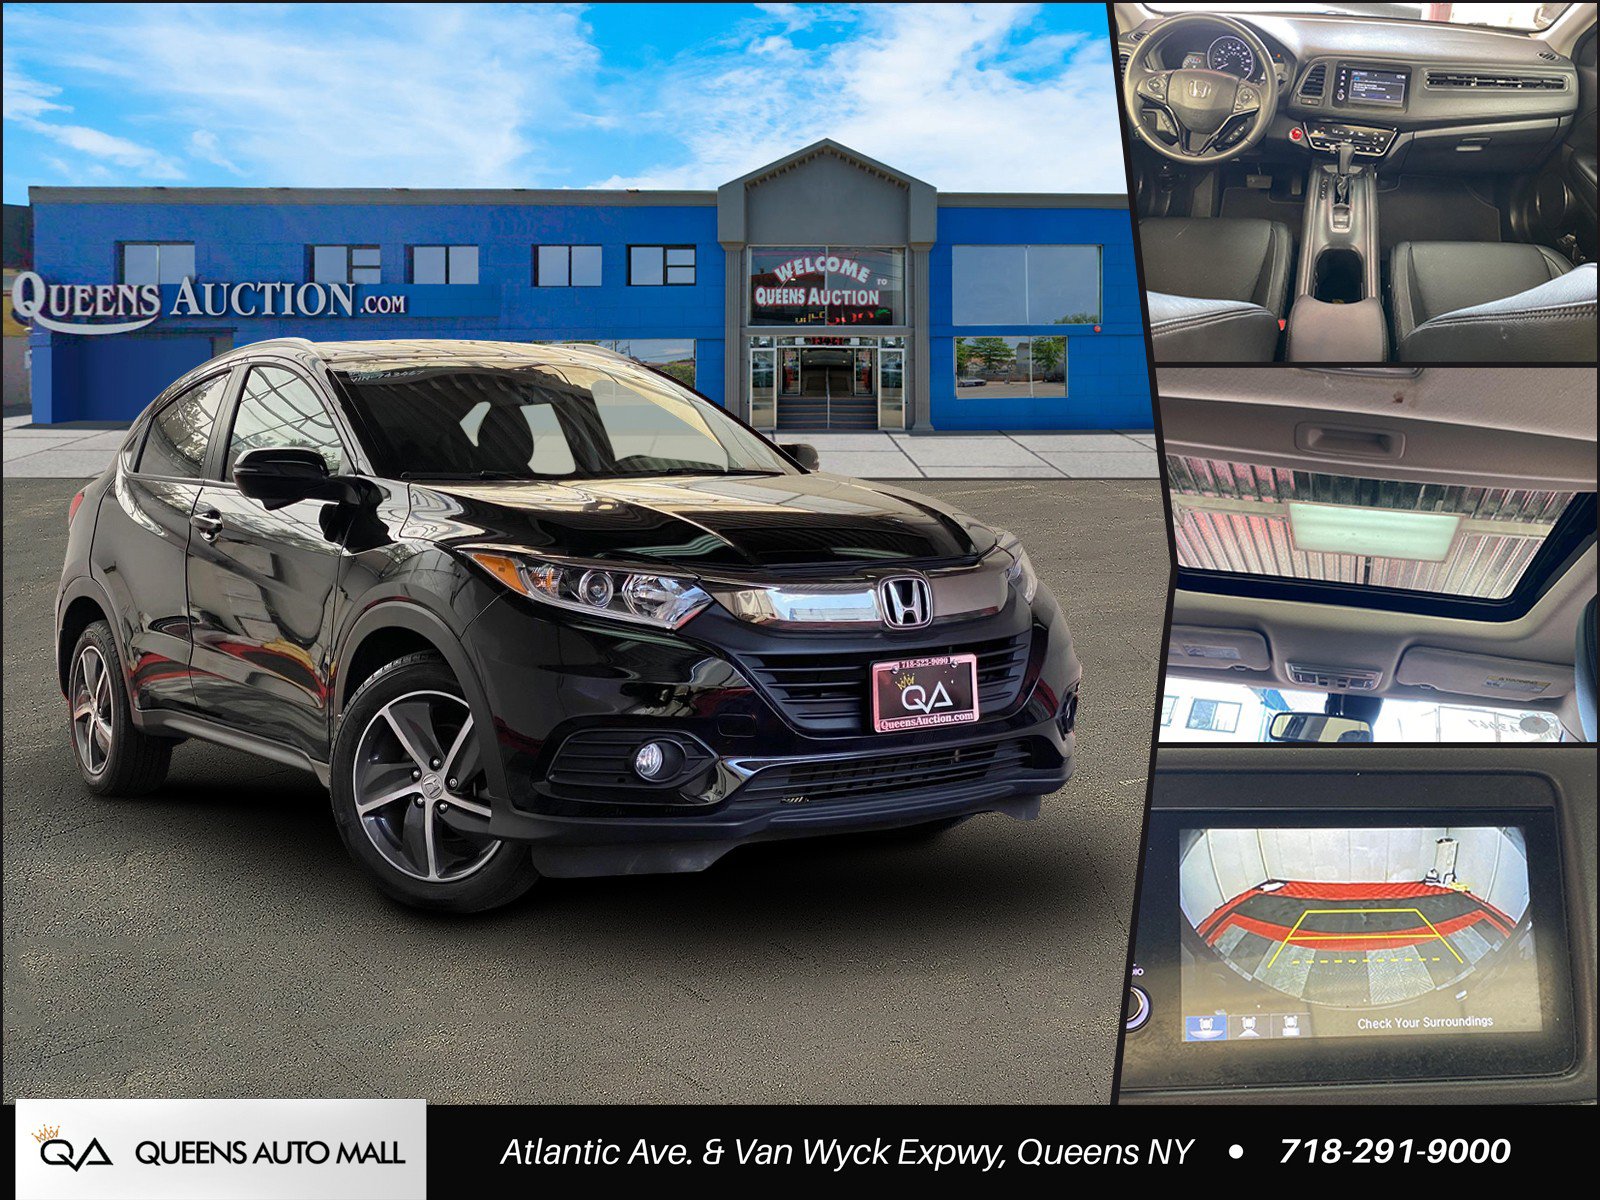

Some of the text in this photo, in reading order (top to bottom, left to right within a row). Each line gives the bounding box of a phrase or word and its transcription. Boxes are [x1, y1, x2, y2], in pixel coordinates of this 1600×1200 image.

[774, 255, 870, 284] WELCOME
[11, 270, 161, 335] QUEENS
[755, 286, 879, 306] QUEENS AUCTION
[880, 712, 974, 730] QueensAuction.com
[1357, 1015, 1494, 1030] Check Your Surroundings
